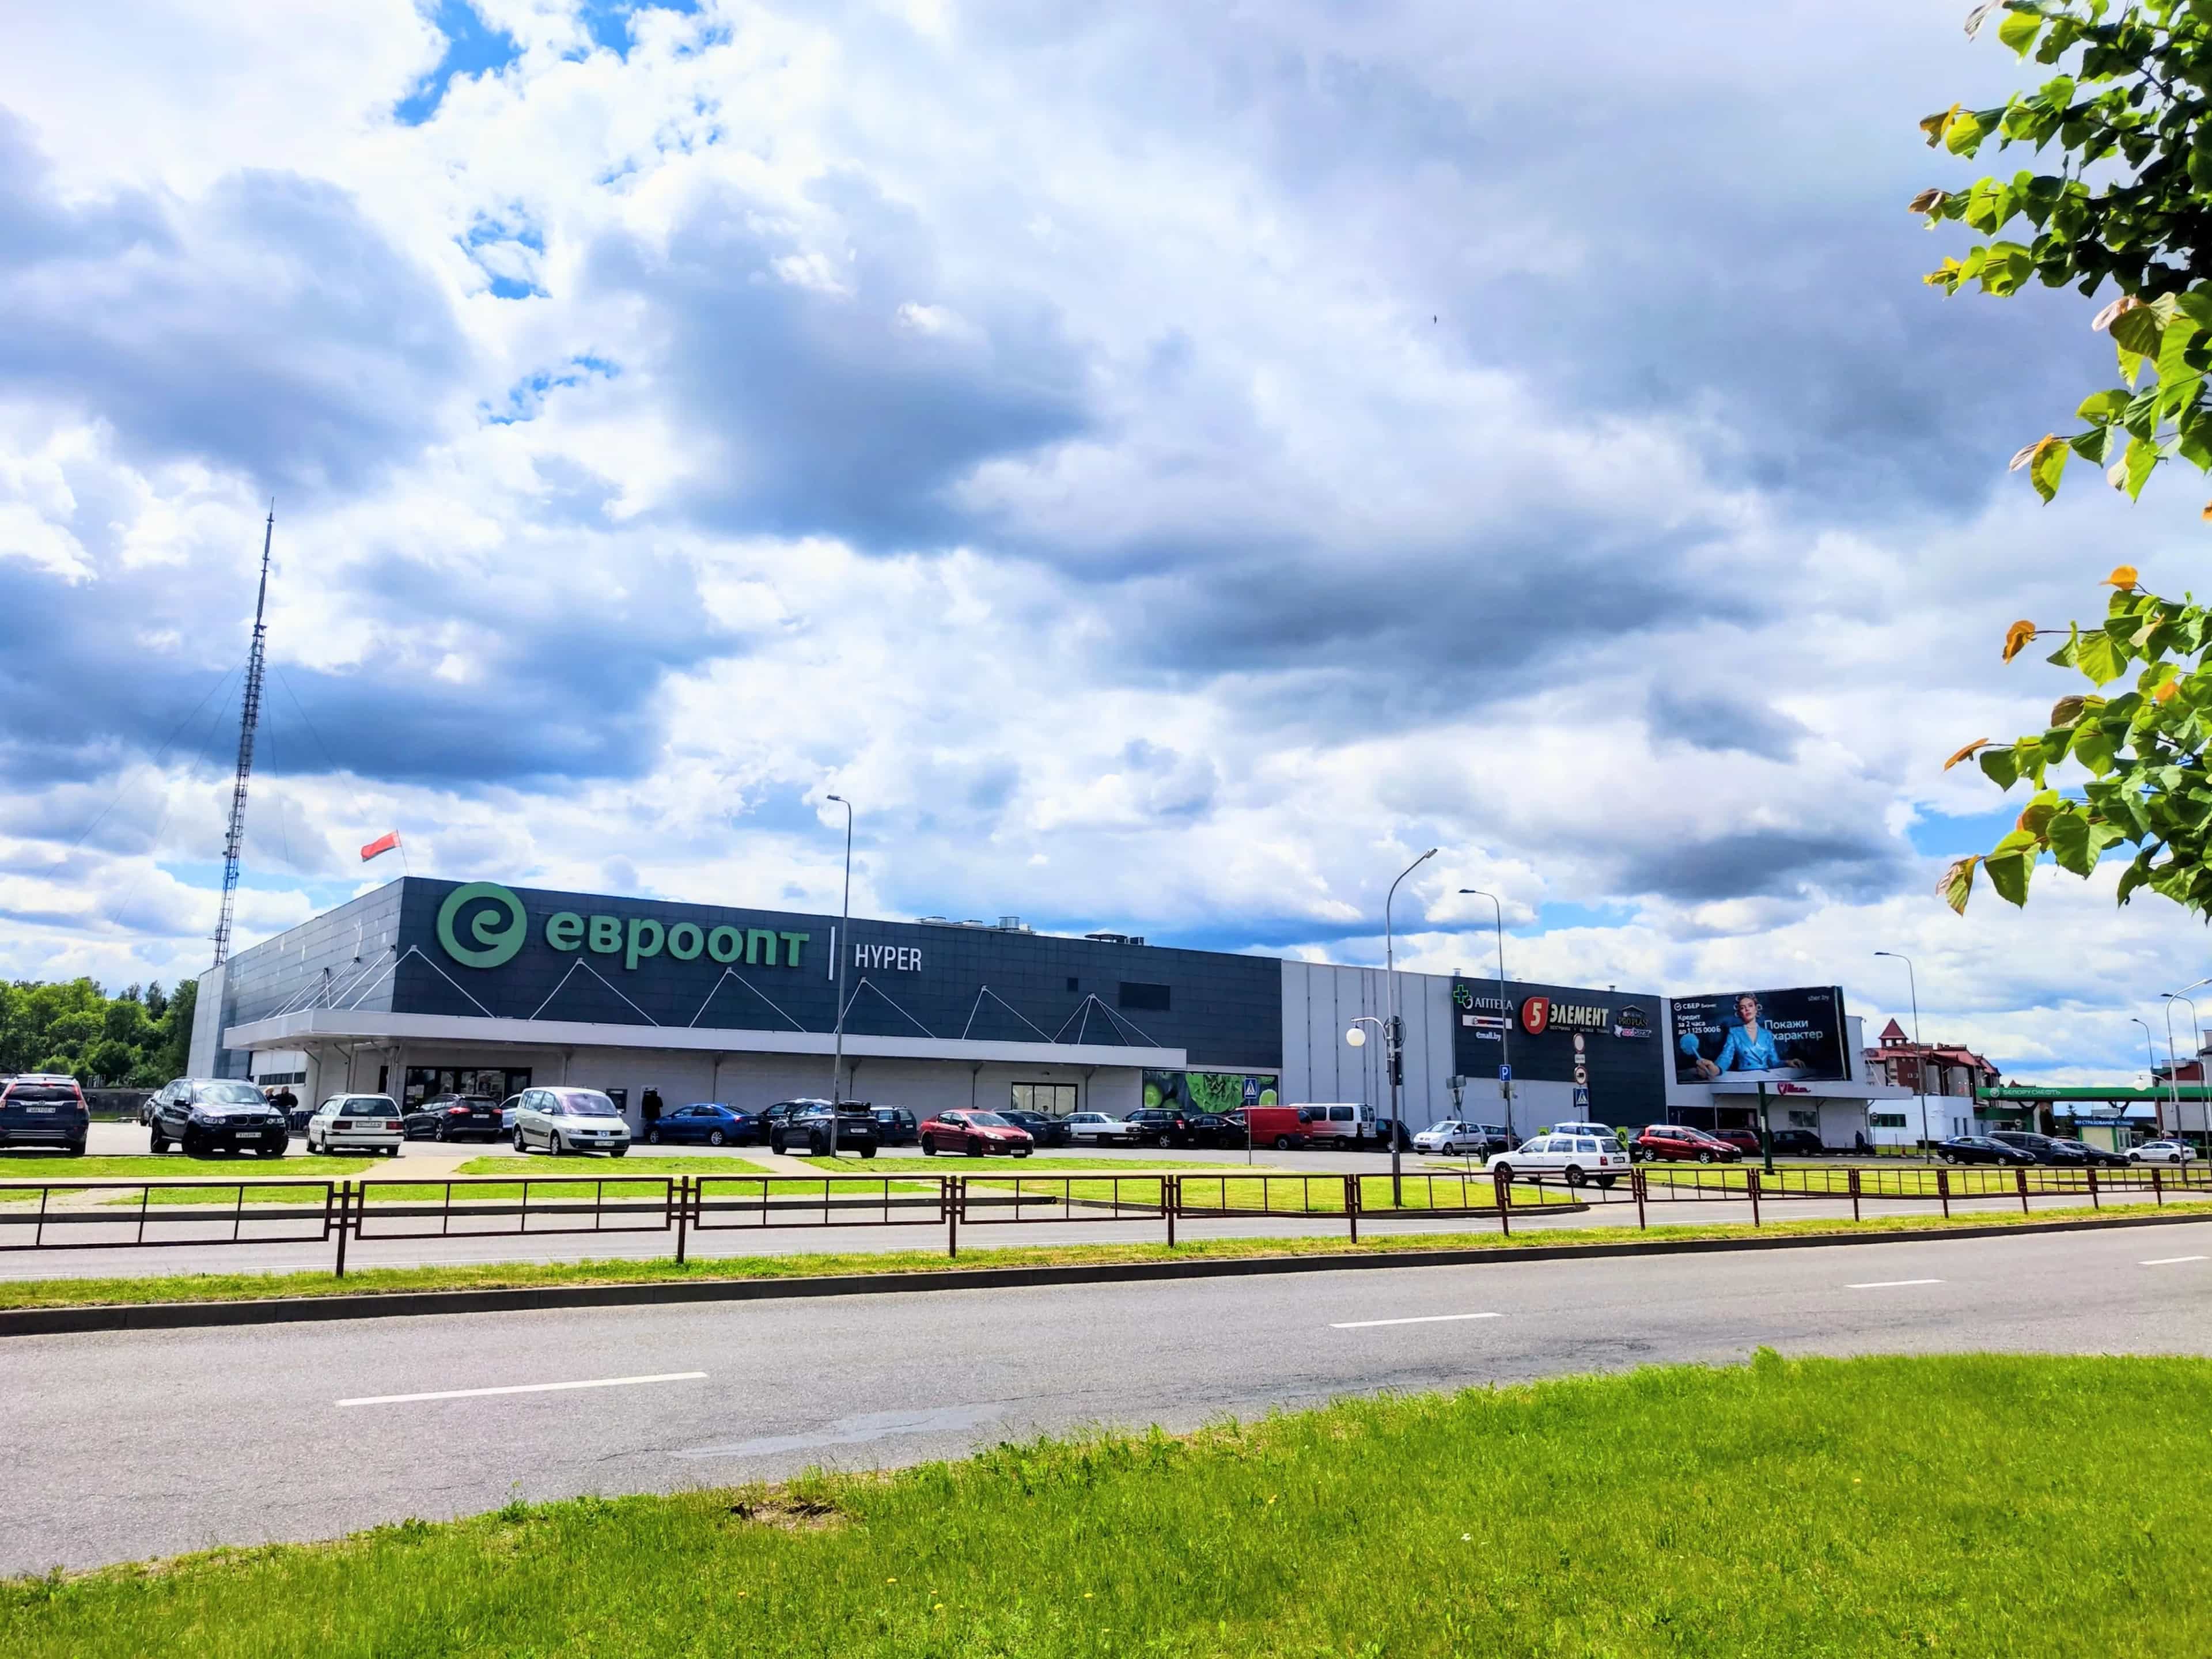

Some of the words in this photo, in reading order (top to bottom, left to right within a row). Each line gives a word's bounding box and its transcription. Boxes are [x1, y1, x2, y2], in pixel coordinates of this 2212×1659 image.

[546, 911, 810, 970] евроопт
[855, 944, 923, 972] HYPER
[1530, 1002, 1542, 1027] 5
[1550, 1004, 1609, 1027] ЭЛЕМЕНТ
[1764, 1020, 1809, 1029] Покажи
[1772, 1031, 1823, 1042] характер
[1502, 1067, 1508, 1080] P
